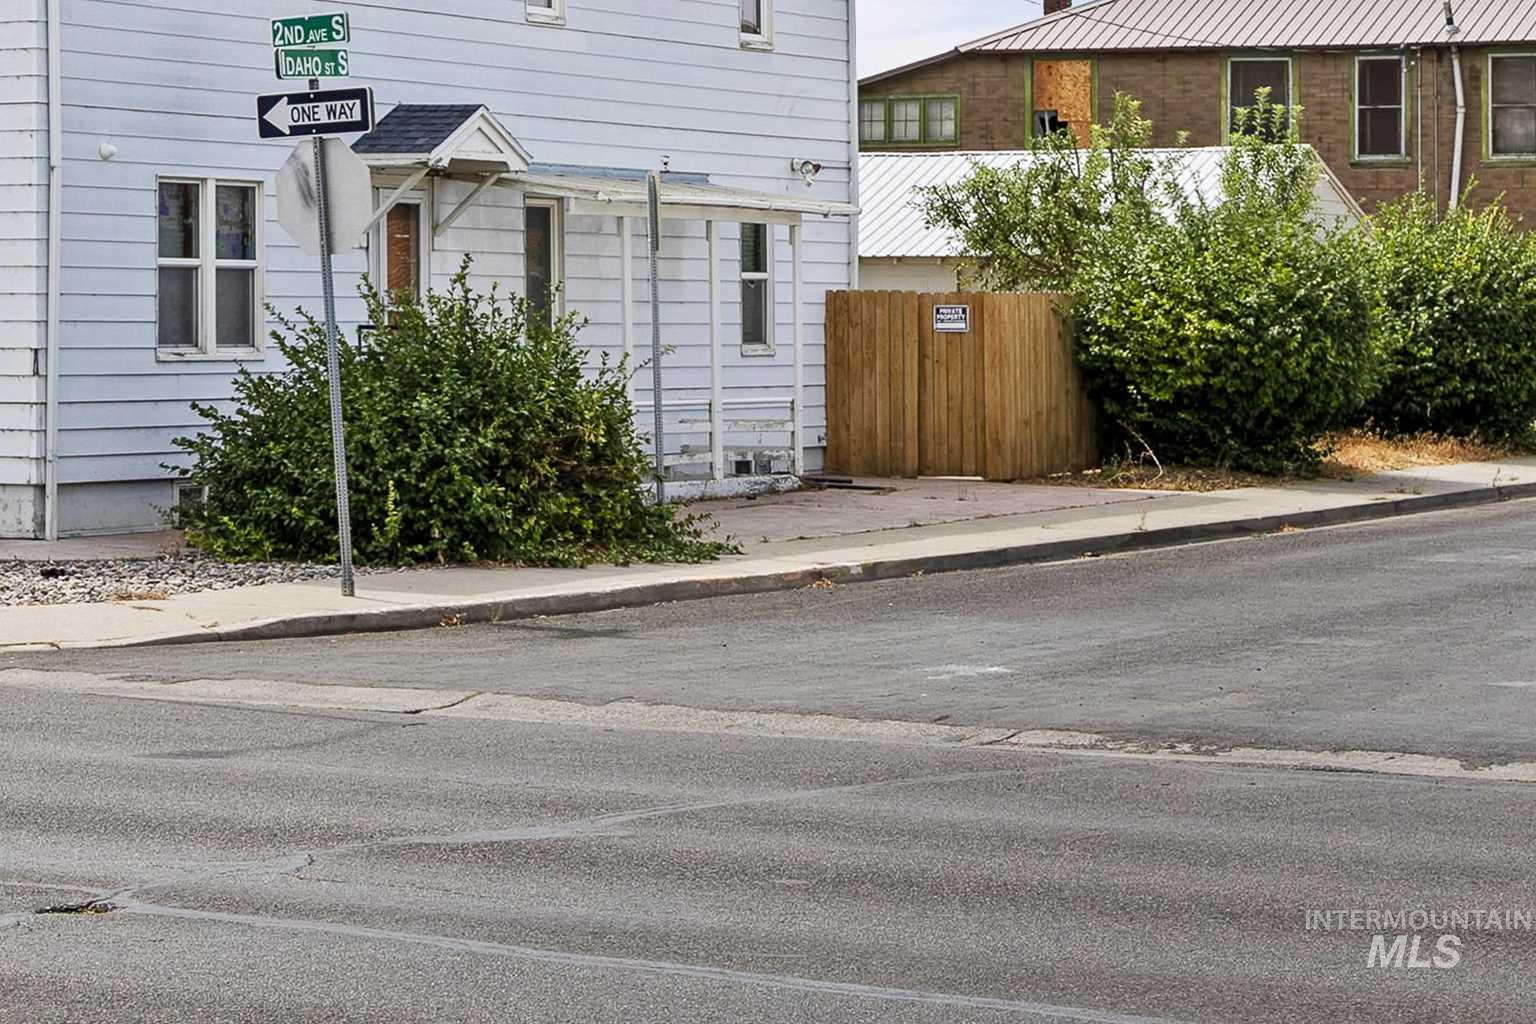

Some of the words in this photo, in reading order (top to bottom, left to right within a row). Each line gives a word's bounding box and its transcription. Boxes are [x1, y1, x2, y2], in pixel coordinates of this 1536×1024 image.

[273, 21, 305, 46] 2ND
[308, 29, 328, 43] AVE
[331, 16, 344, 40] S
[282, 51, 322, 76] IDAHO
[324, 63, 335, 75] ST
[337, 51, 348, 75] S
[290, 105, 321, 123] ONE
[325, 102, 356, 121] WAY
